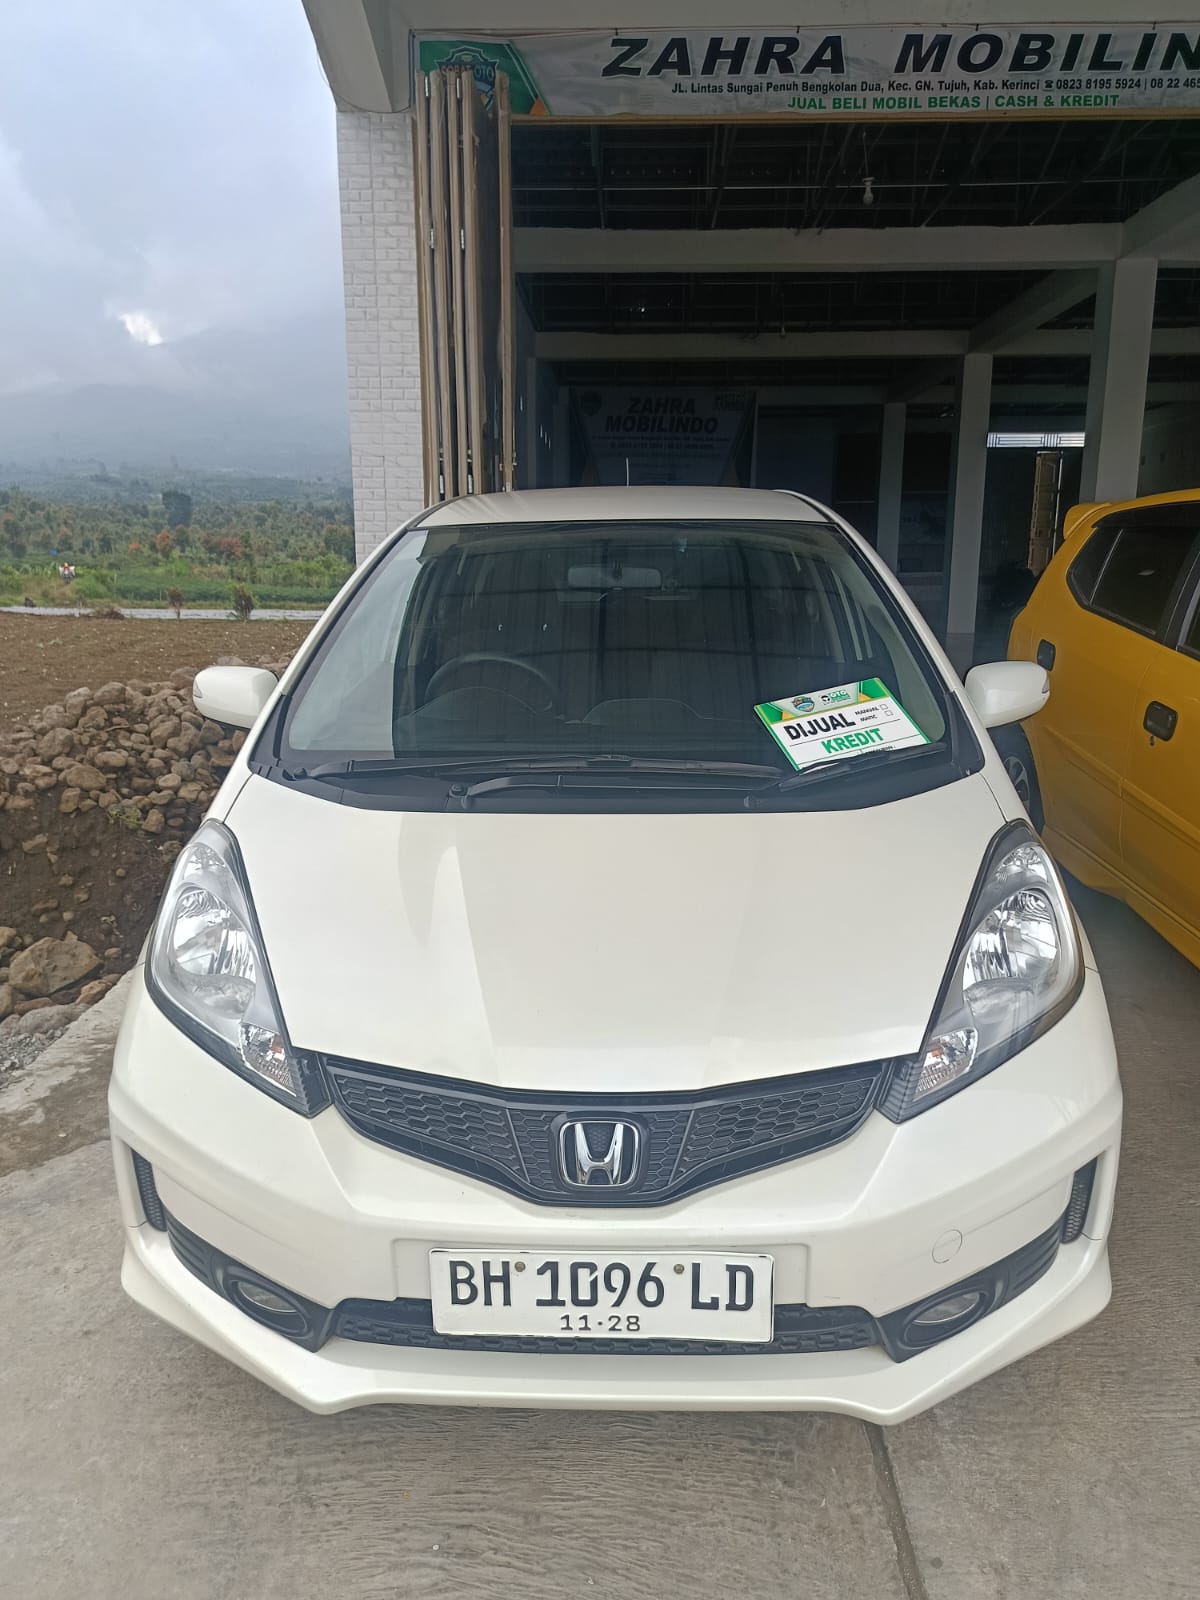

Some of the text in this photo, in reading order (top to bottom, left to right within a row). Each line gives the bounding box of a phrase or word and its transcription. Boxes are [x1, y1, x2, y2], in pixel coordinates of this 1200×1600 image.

[601, 33, 1200, 77] ZAHRA MOBILIN
[474, 65, 495, 82] OTO
[671, 83, 688, 94] JL.
[691, 82, 724, 94] Lintas
[727, 82, 763, 95] Sungai
[766, 81, 799, 93] Penuh
[802, 81, 857, 94] Bengkolan
[860, 81, 884, 93] Dua,
[888, 81, 912, 92] Kec.
[915, 80, 934, 91] GN.
[938, 80, 971, 92] Tujuh,
[973, 79, 998, 91] Kab.
[1001, 79, 1040, 90] Kerinci
[1056, 79, 1082, 90] 0823
[1085, 78, 1112, 89] 8195
[1115, 78, 1141, 89] 5924
[1150, 78, 1163, 88] 08
[1166, 78, 1180, 88] 22
[787, 96, 827, 110] JUAL
[832, 97, 867, 110] BELI
[872, 96, 922, 110] MOBIL
[928, 95, 981, 109] BEKAS
[995, 95, 1040, 108] CASH
[1043, 95, 1054, 107] &
[1060, 95, 1119, 108] KREDIT
[627, 397, 696, 414] ZAHRA
[605, 415, 719, 433] MOBILINDO
[784, 713, 856, 740] DIJUAL
[821, 728, 884, 754] KREDIT
[449, 1260, 754, 1312] BH 1096 LD
